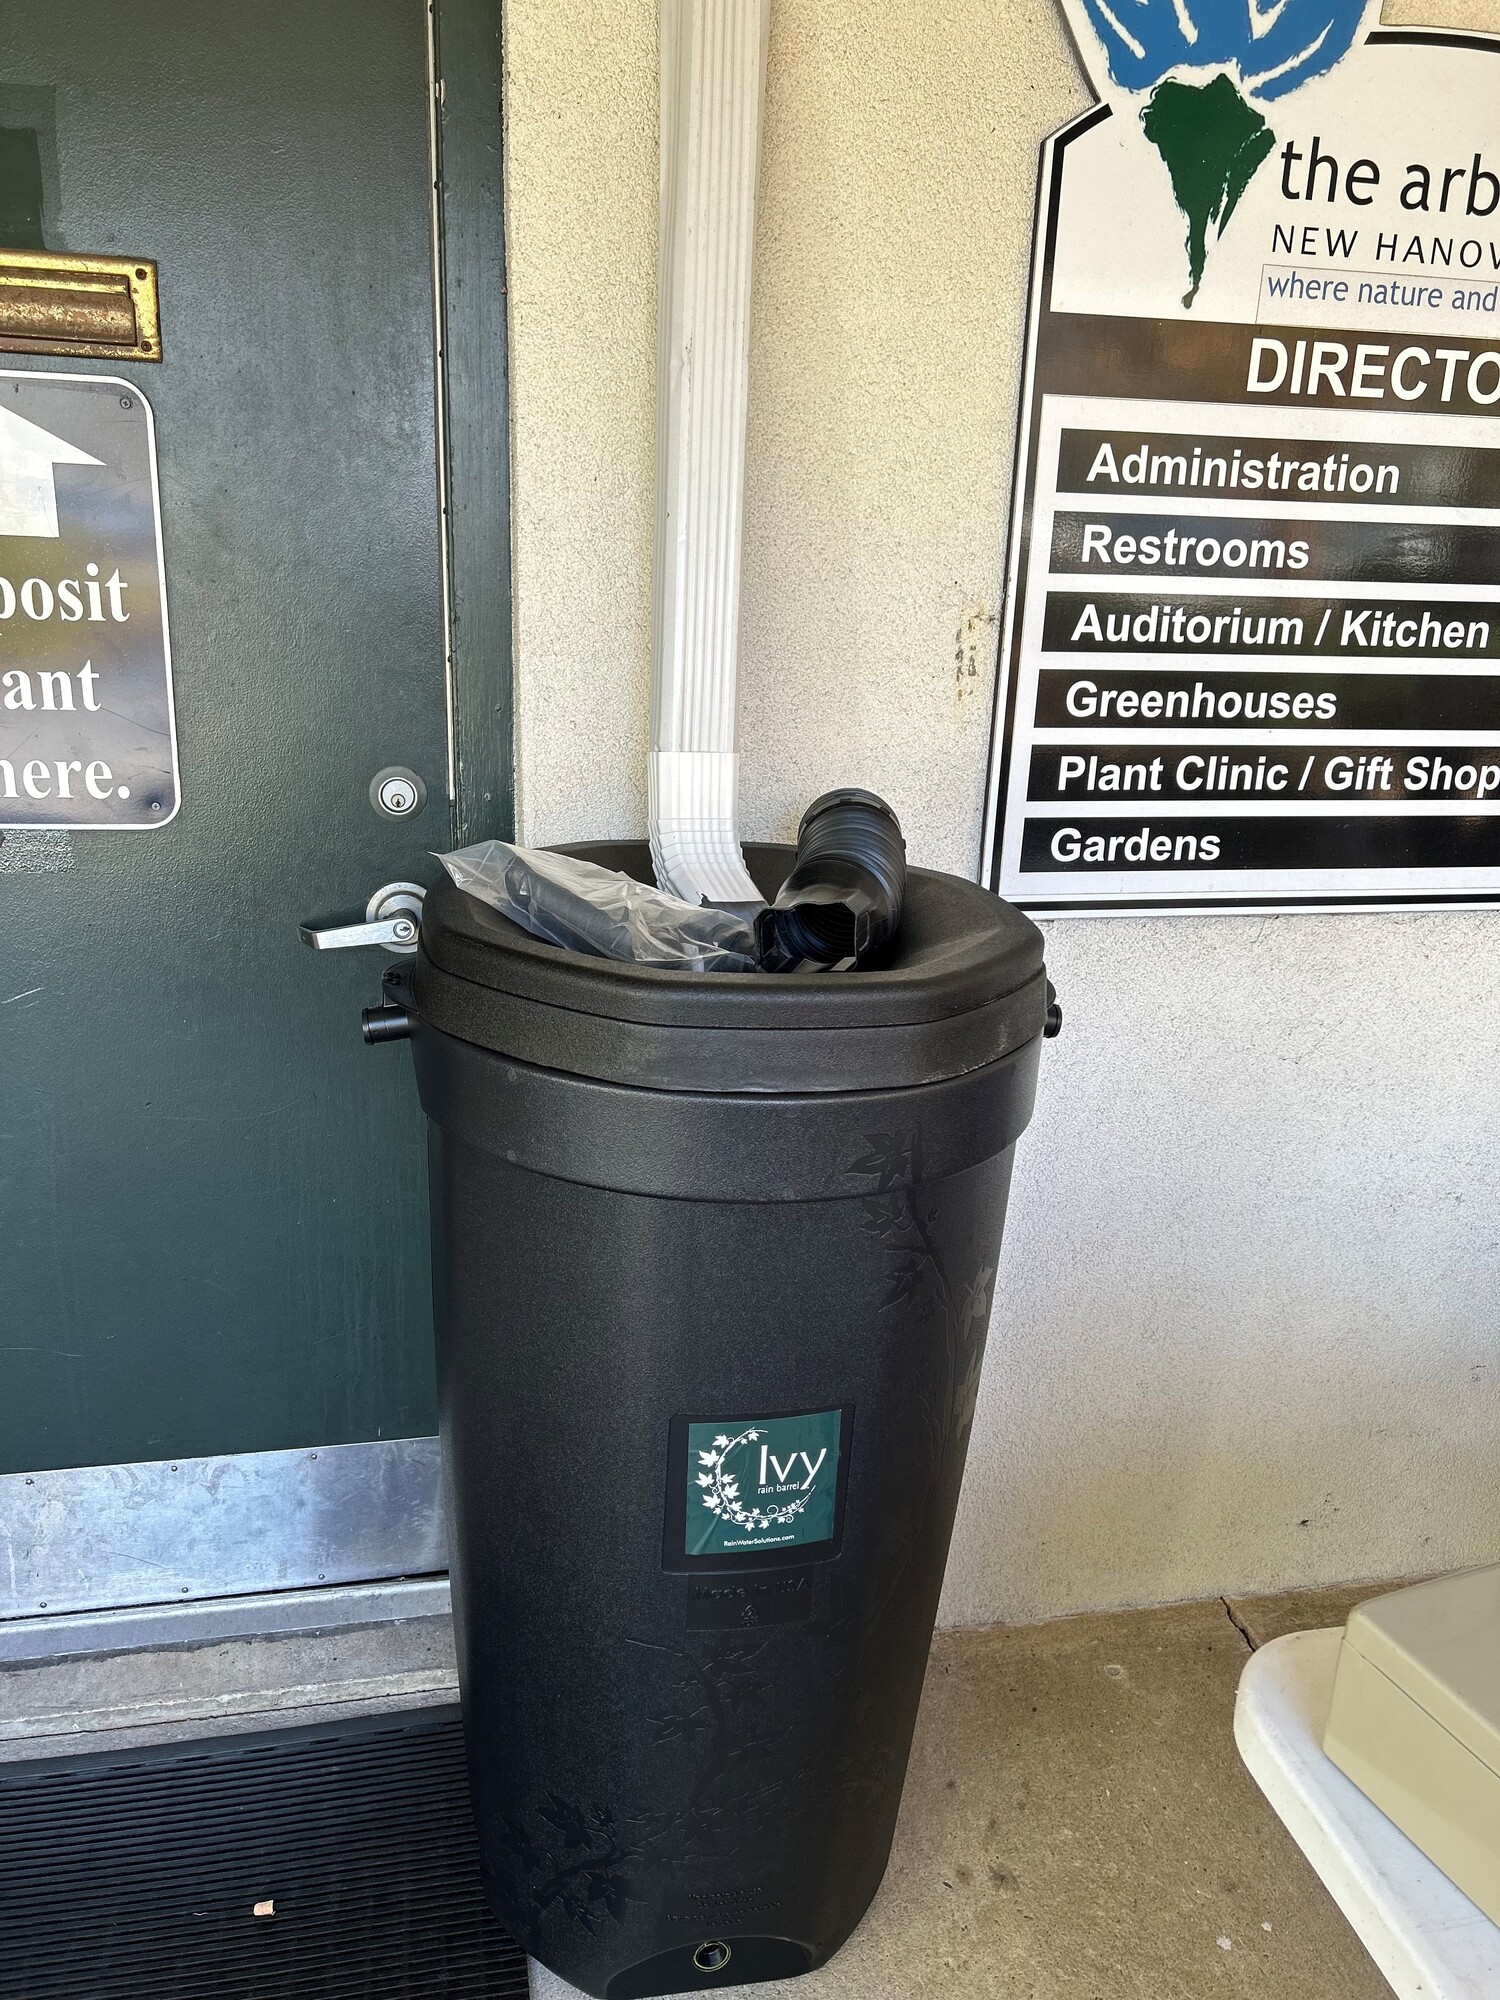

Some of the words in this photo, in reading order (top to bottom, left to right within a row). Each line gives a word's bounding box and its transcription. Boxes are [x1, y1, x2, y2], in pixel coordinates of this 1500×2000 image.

[1280, 136, 1381, 206] the
[1400, 153, 1500, 216] arb
[1272, 224, 1358, 258] NEW
[1268, 271, 1349, 302] where
[1358, 279, 1443, 308] nature
[1451, 285, 1499, 312] and
[1246, 337, 1500, 405] DIRECTO
[1086, 442, 1401, 494] Administration
[1081, 524, 1310, 570] Restrooms
[1070, 603, 1304, 645] Auditorium
[1314, 608, 1332, 646] /
[1340, 609, 1490, 649] Kitchen
[0, 659, 102, 712] ant
[1065, 680, 1338, 720] Greenhouses
[1057, 755, 1164, 791] Plant
[1175, 755, 1289, 791] Clinic
[1297, 755, 1316, 791] /
[1324, 755, 1394, 791] Gift
[1403, 755, 1500, 799] Shop
[1050, 827, 1221, 863] Gardens
[757, 1485, 774, 1495] rain
[776, 1480, 800, 1493] barrel
[758, 1444, 827, 1491] Ivy
[723, 1534, 795, 1547] RainWaterSolutions.com
